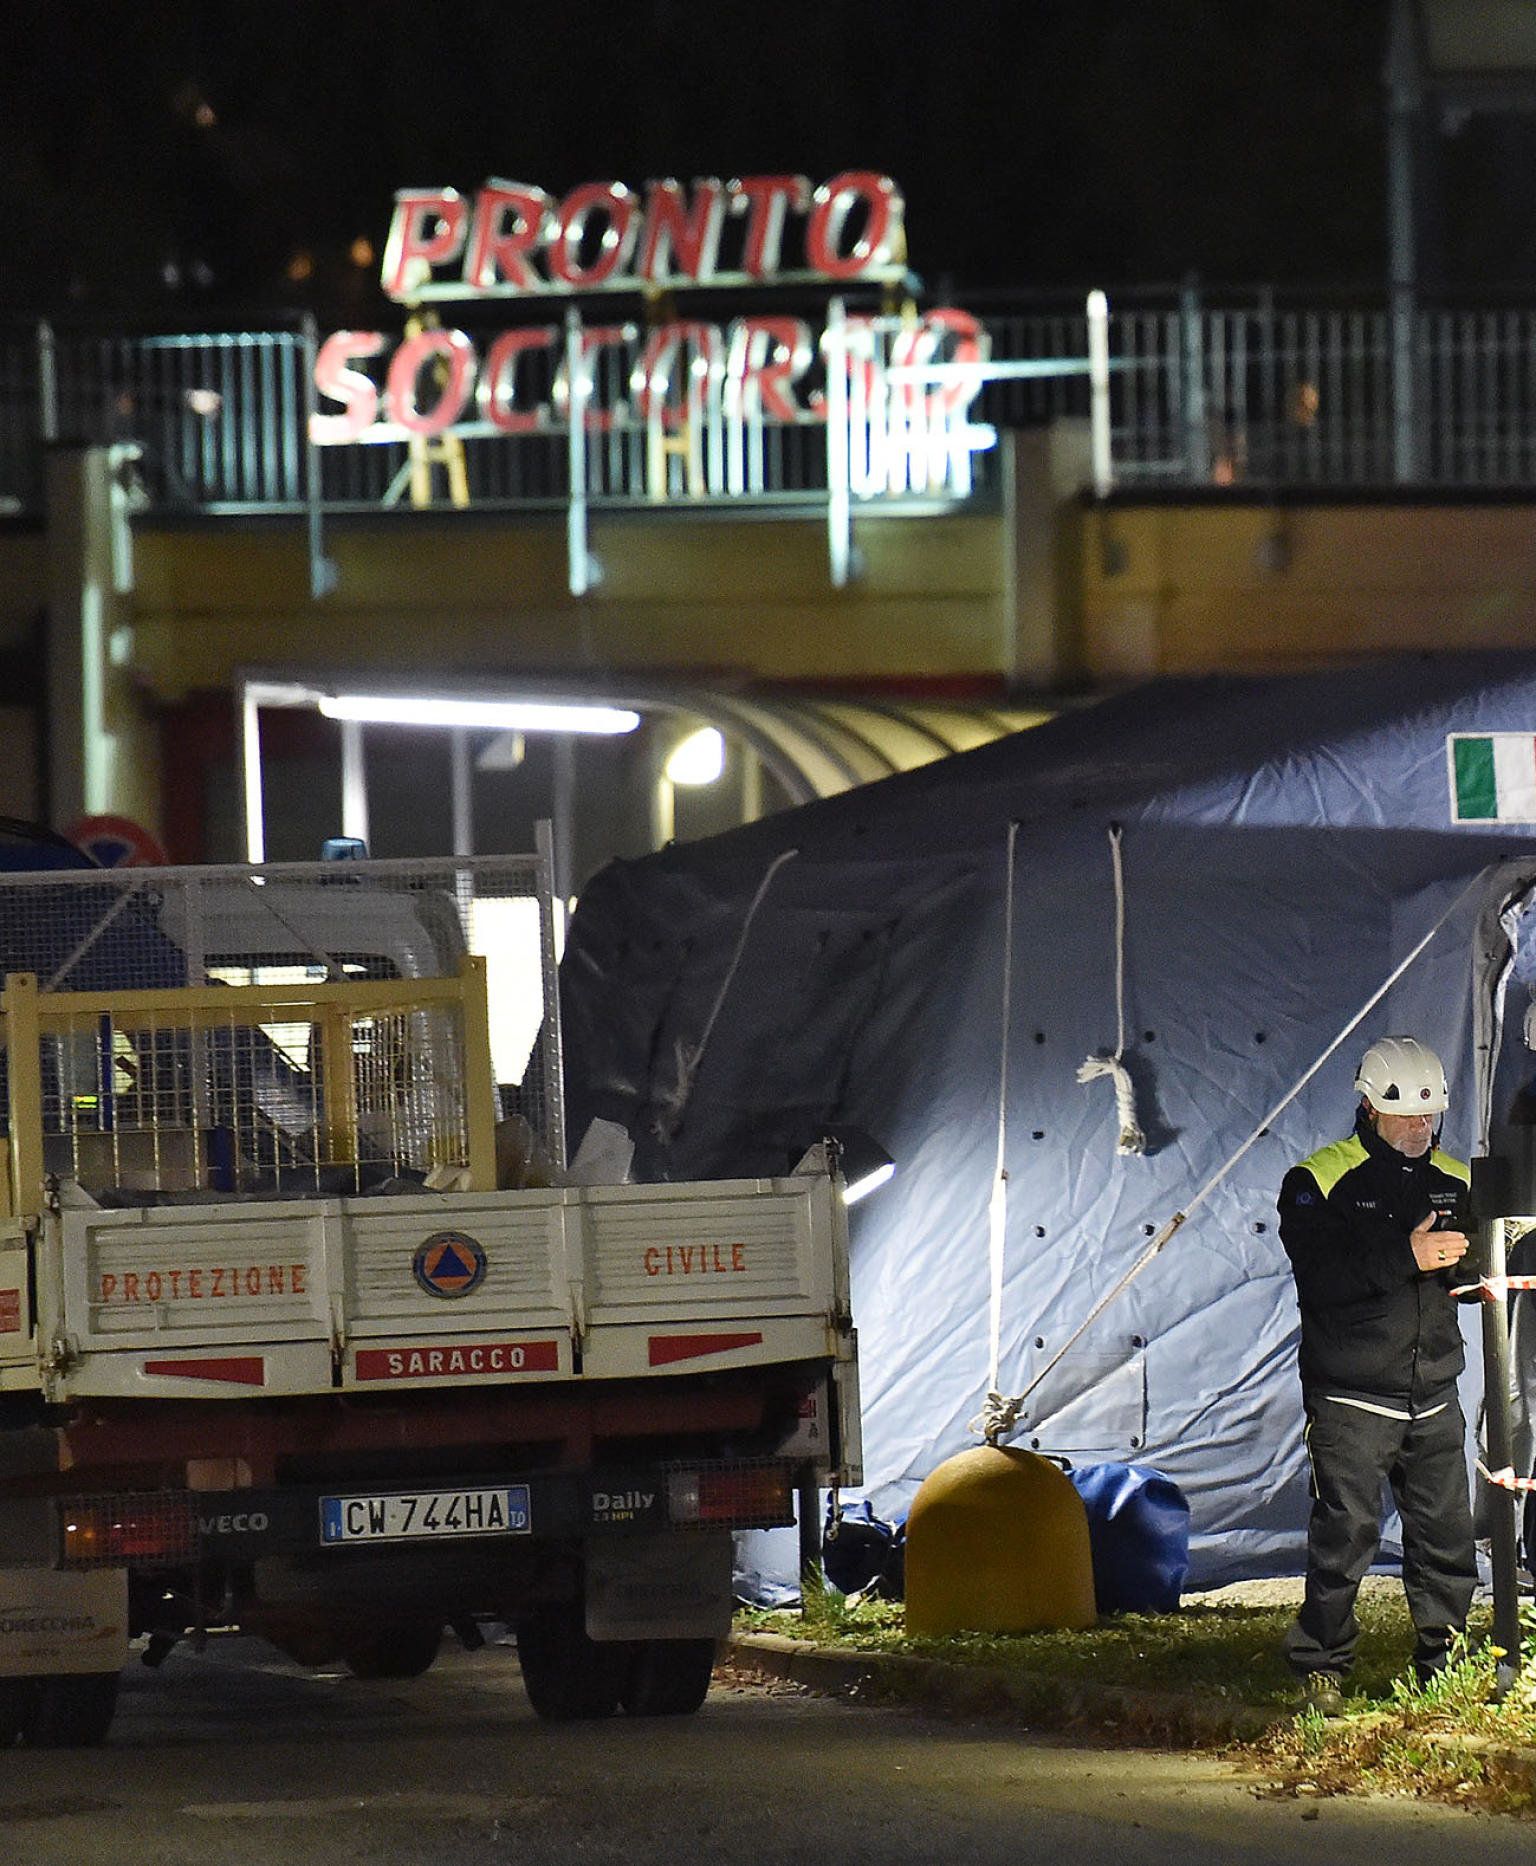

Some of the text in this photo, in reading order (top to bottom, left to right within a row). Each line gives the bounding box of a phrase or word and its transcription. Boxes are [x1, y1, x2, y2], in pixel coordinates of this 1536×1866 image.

[382, 169, 906, 300] PRONTO
[101, 1243, 748, 1303] PROTEZIONE CIVILE
[388, 1347, 526, 1375] SARACCO
[592, 1491, 655, 1511] Daily
